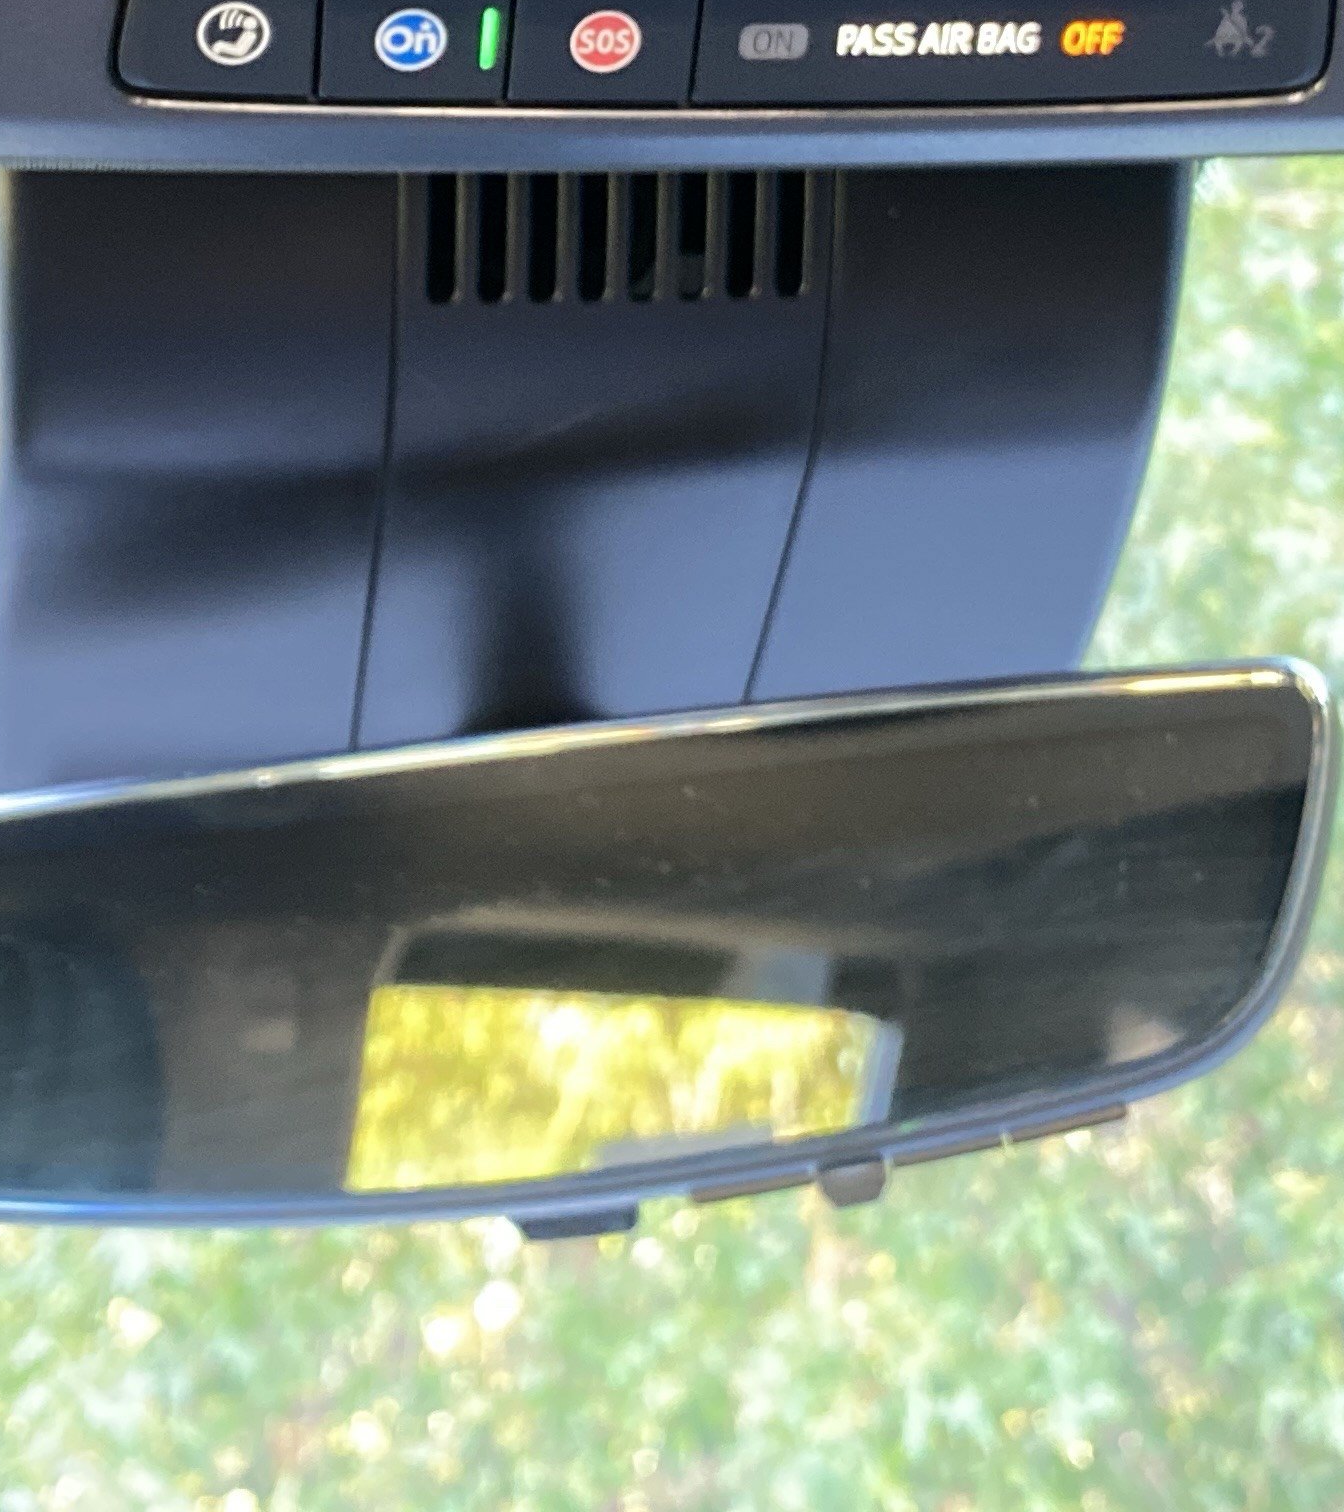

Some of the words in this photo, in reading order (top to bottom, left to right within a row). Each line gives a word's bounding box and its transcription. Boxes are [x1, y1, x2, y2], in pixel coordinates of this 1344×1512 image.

[576, 27, 632, 55] SOS
[754, 28, 794, 53] ON
[836, 22, 916, 57] PASS
[918, 23, 974, 56] AIR
[977, 23, 1042, 56] BAG
[1061, 20, 1126, 56] OFF
